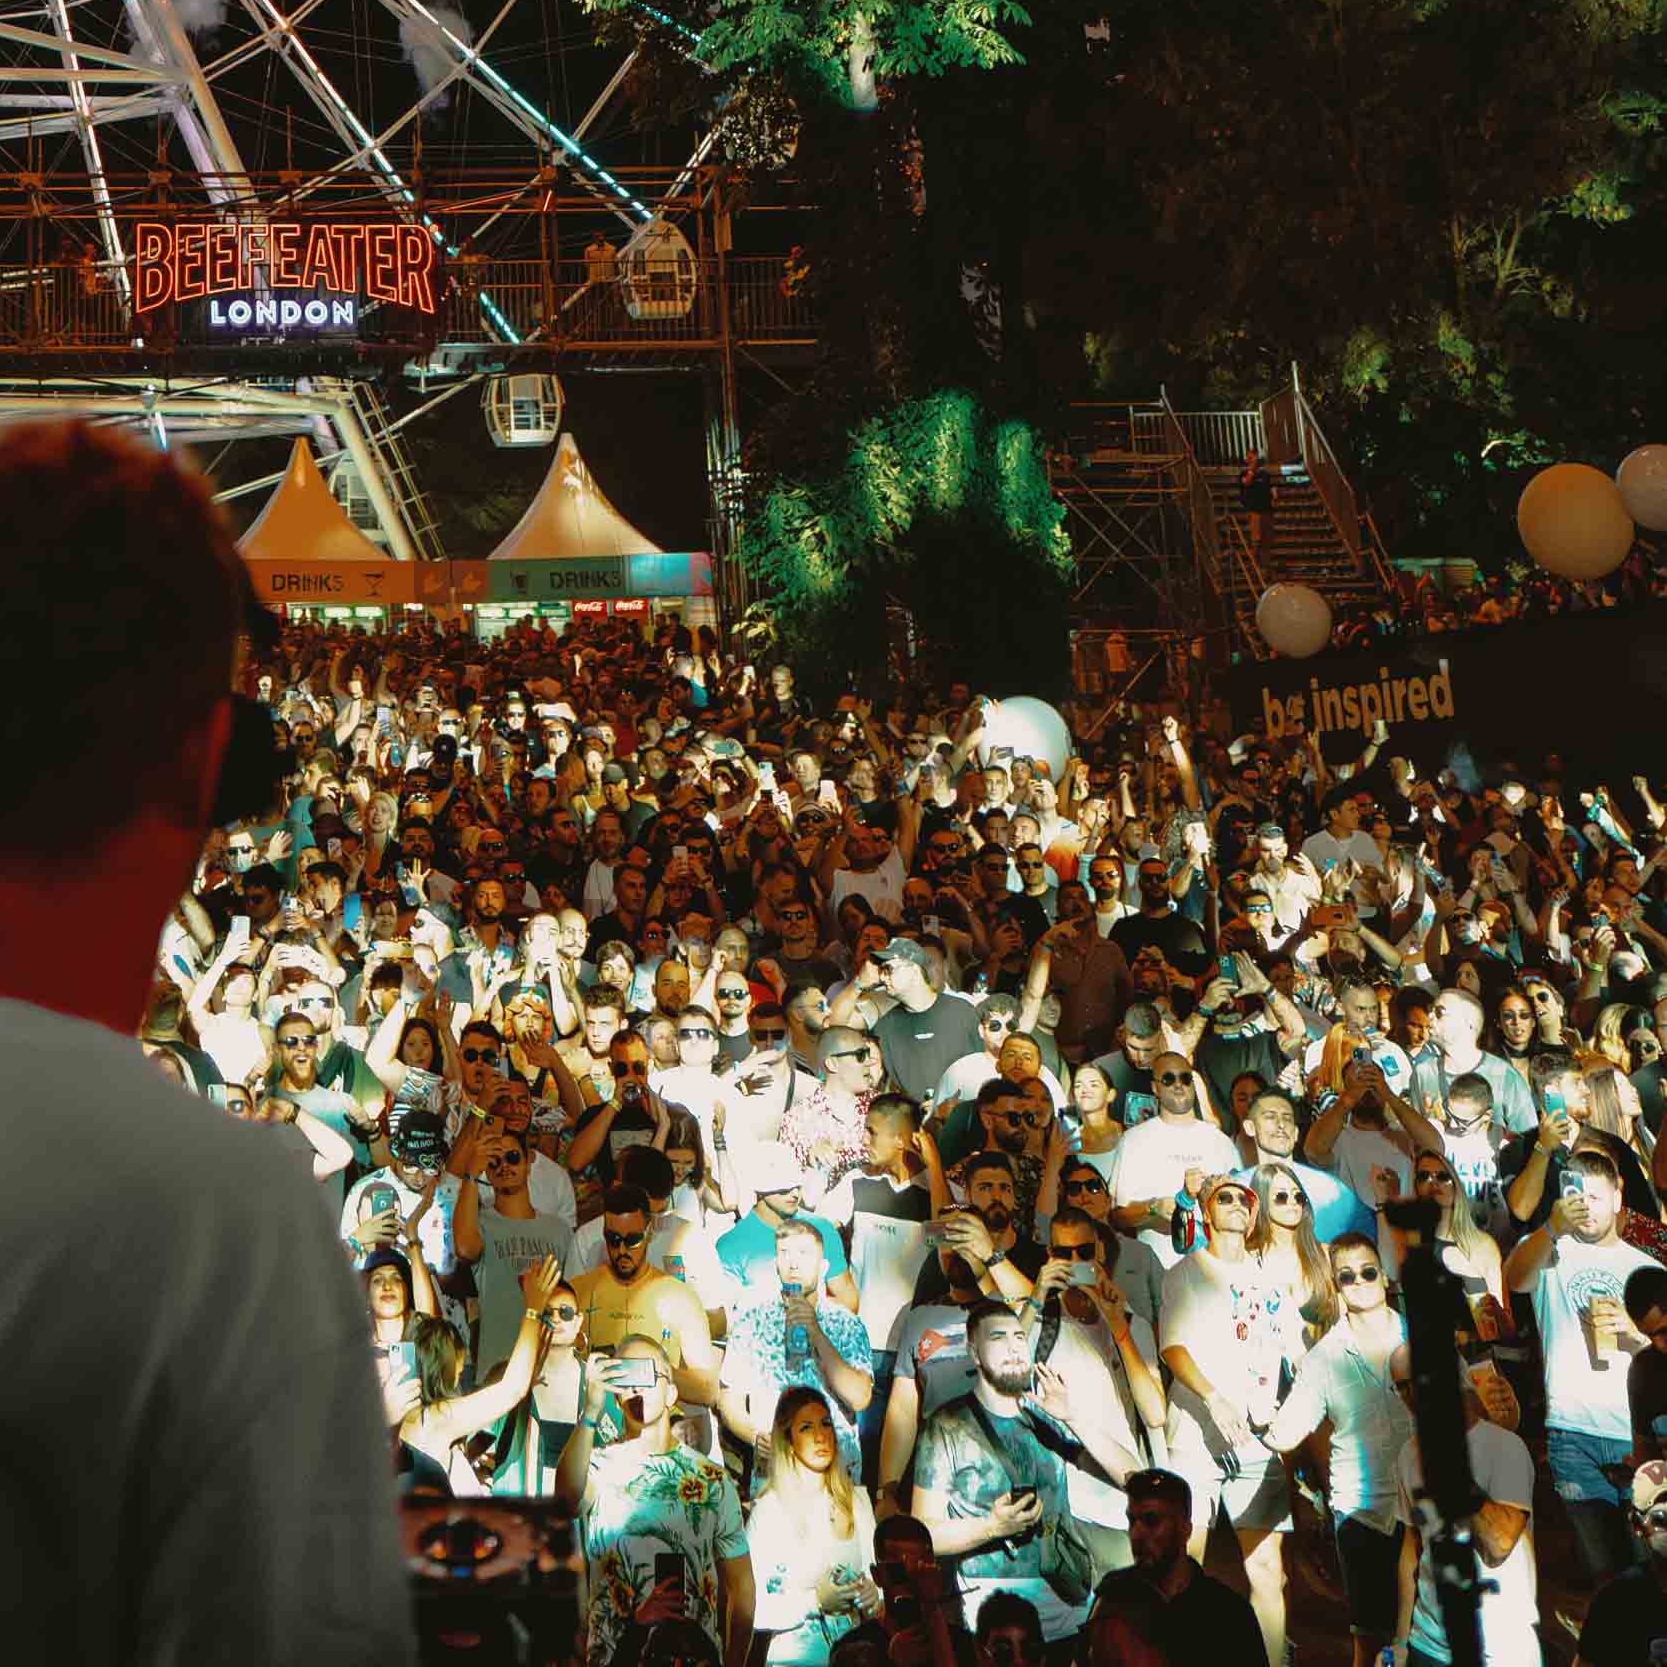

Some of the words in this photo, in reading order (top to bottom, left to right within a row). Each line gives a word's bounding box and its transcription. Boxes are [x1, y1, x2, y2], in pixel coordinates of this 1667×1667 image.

[134, 223, 435, 315] BEEFEATER
[209, 299, 355, 325] LONDON
[270, 573, 345, 592] DRINKS
[551, 571, 621, 588] DRINKS
[1309, 658, 1455, 738] inspired
